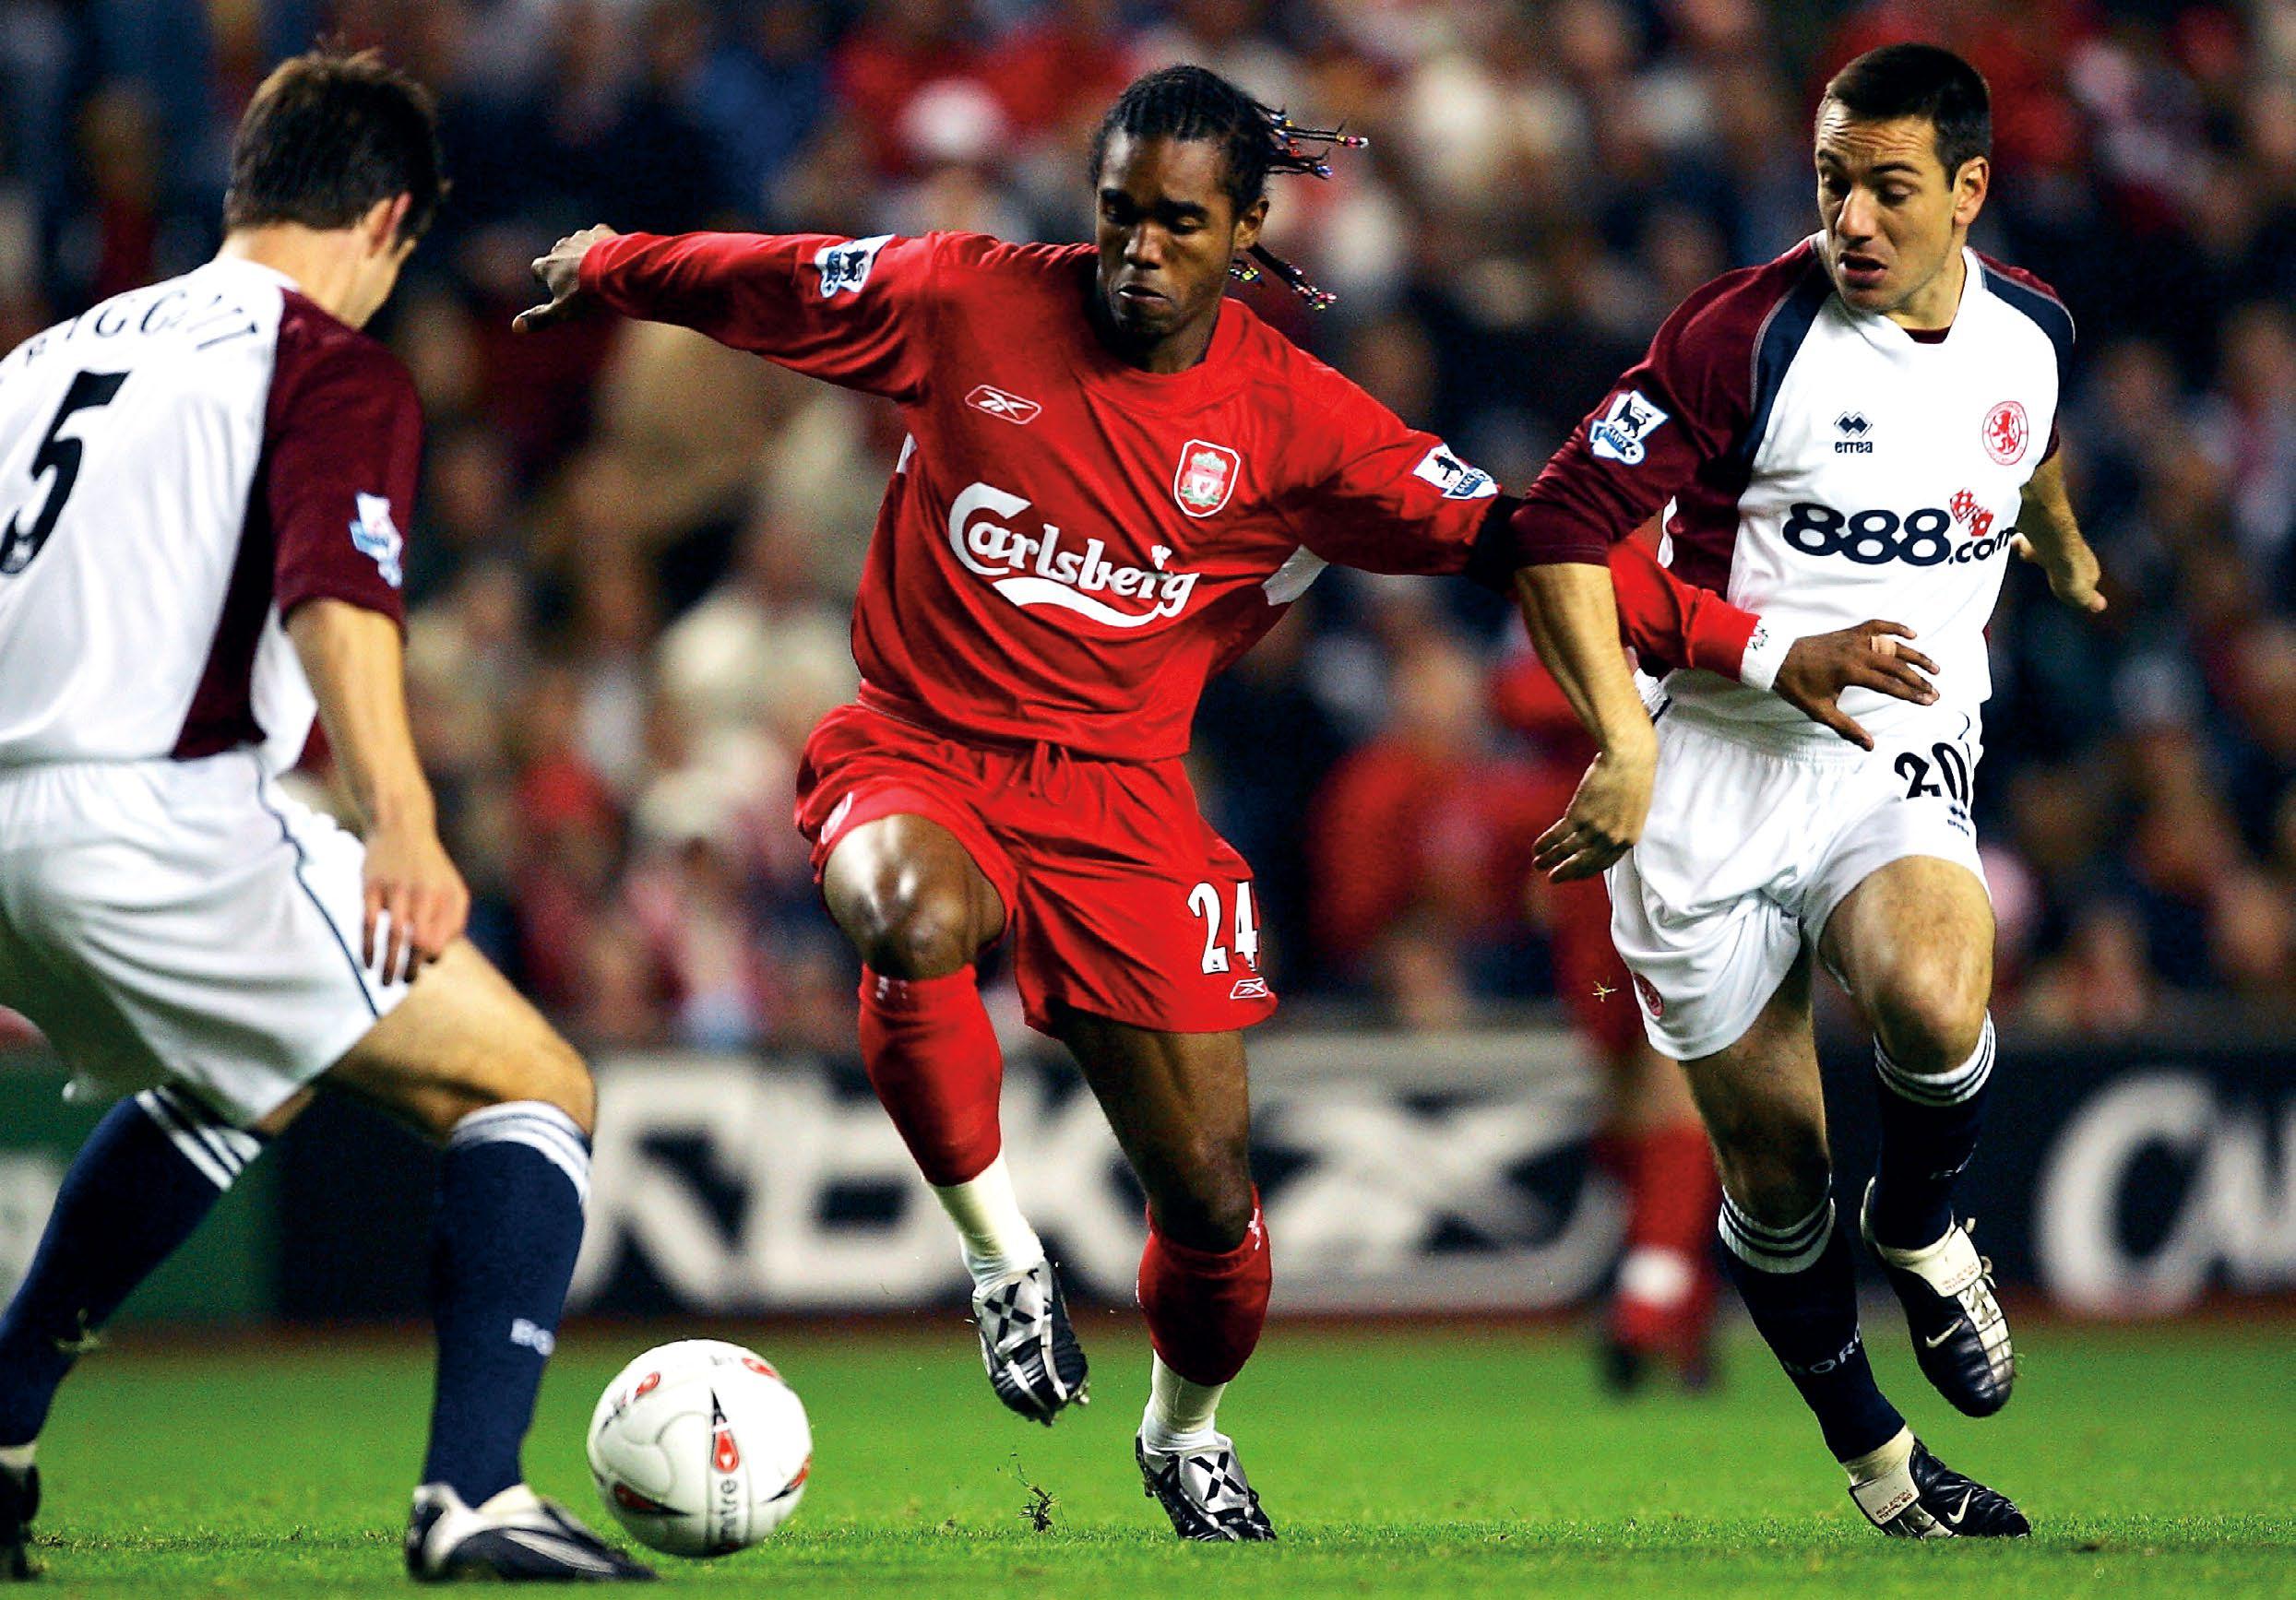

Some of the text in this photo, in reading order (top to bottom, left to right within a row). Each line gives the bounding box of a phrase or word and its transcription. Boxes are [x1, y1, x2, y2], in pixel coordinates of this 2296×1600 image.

[0, 370, 131, 575] 5
[1835, 440, 1873, 454] errea
[948, 481, 1199, 618] Carlsberg
[1894, 742, 1969, 810] 20
[1187, 882, 1258, 974] 24
